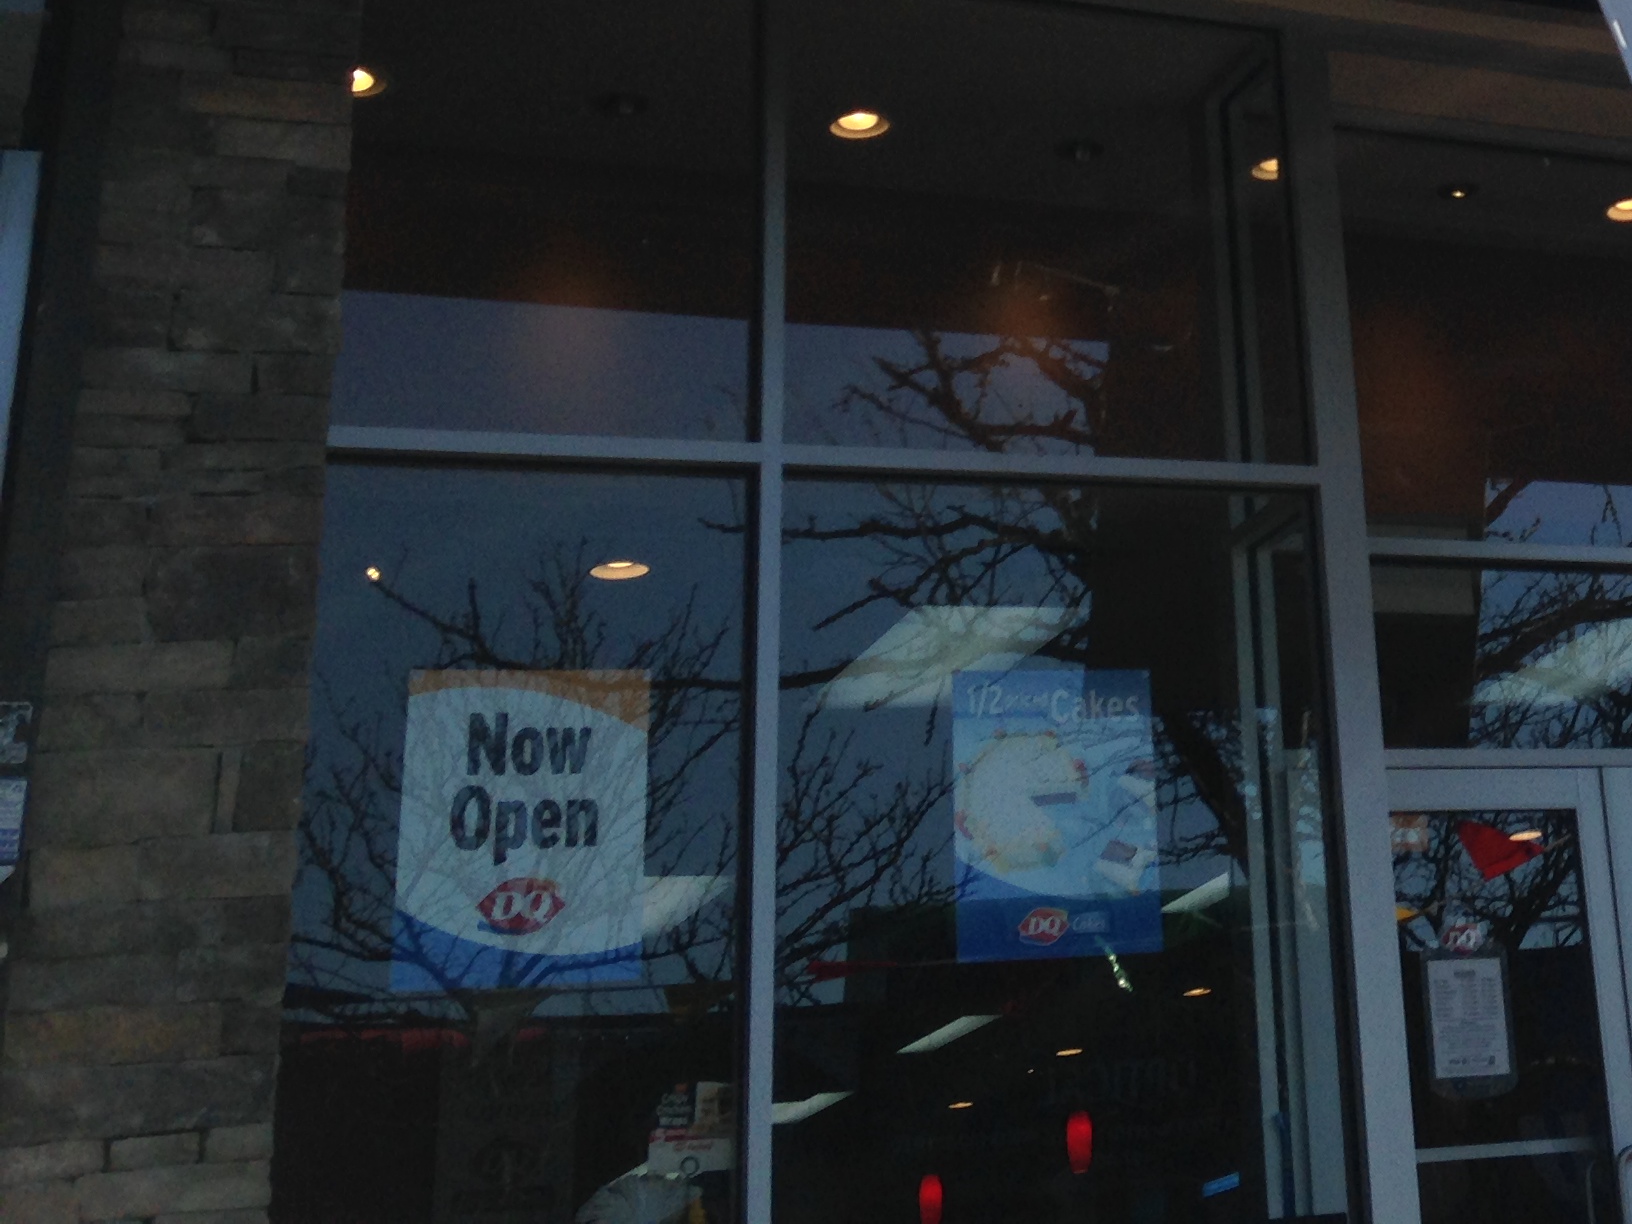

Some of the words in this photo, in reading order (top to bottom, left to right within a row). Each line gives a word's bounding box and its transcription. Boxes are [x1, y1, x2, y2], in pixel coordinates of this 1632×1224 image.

[967, 682, 1003, 718] 1/2
[1051, 688, 1141, 723] Cakes
[466, 712, 592, 777] Now
[449, 784, 600, 867] Open
[489, 889, 553, 922] DQ
[1028, 915, 1061, 937] DQ
